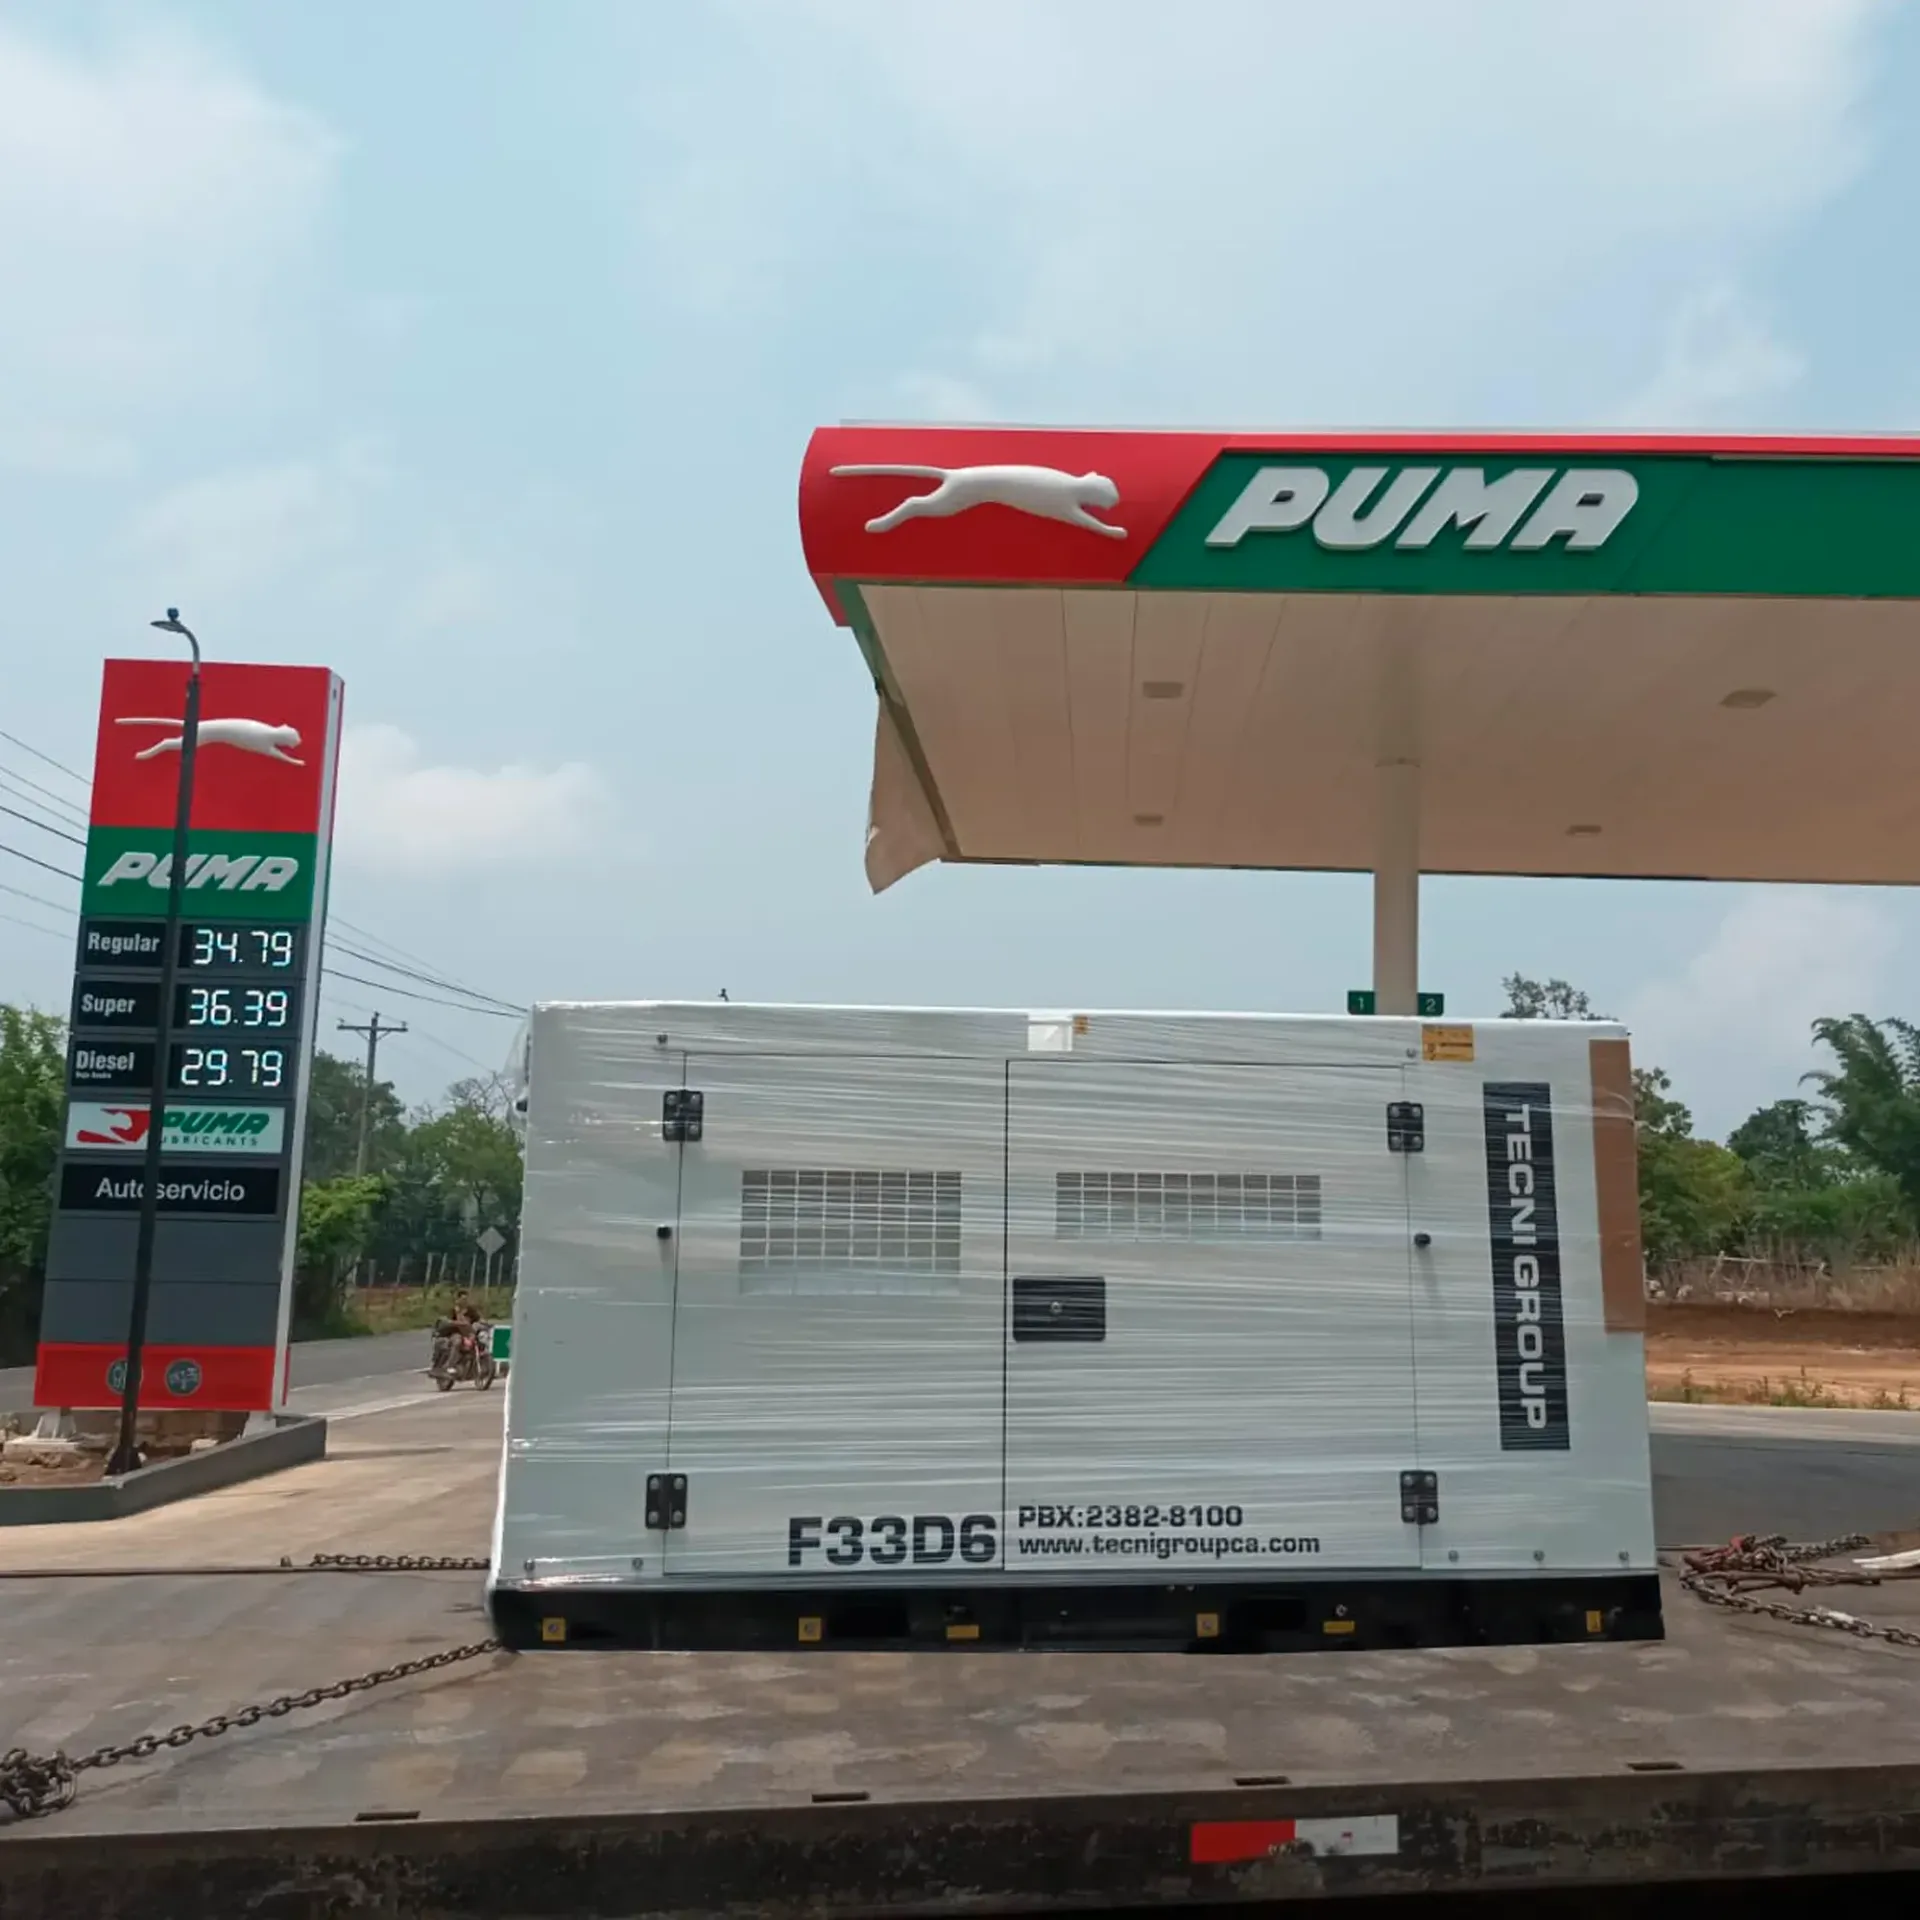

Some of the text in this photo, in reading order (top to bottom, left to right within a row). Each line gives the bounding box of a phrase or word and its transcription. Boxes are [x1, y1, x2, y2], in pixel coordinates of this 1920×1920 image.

[1204, 466, 1640, 551] PUMA
[97, 851, 299, 891] PUMA
[87, 929, 292, 966] Regular 34.79
[81, 989, 288, 1026] Super 36.39
[1357, 996, 1365, 1011] 1
[1426, 998, 1437, 1013] 2
[76, 1049, 283, 1086] Diesel 29.79
[1018, 1504, 1244, 1529] PBX:2382-8100
[787, 1514, 998, 1566] F33D6
[1018, 1533, 1322, 1560] www.tecnigroupca.com
